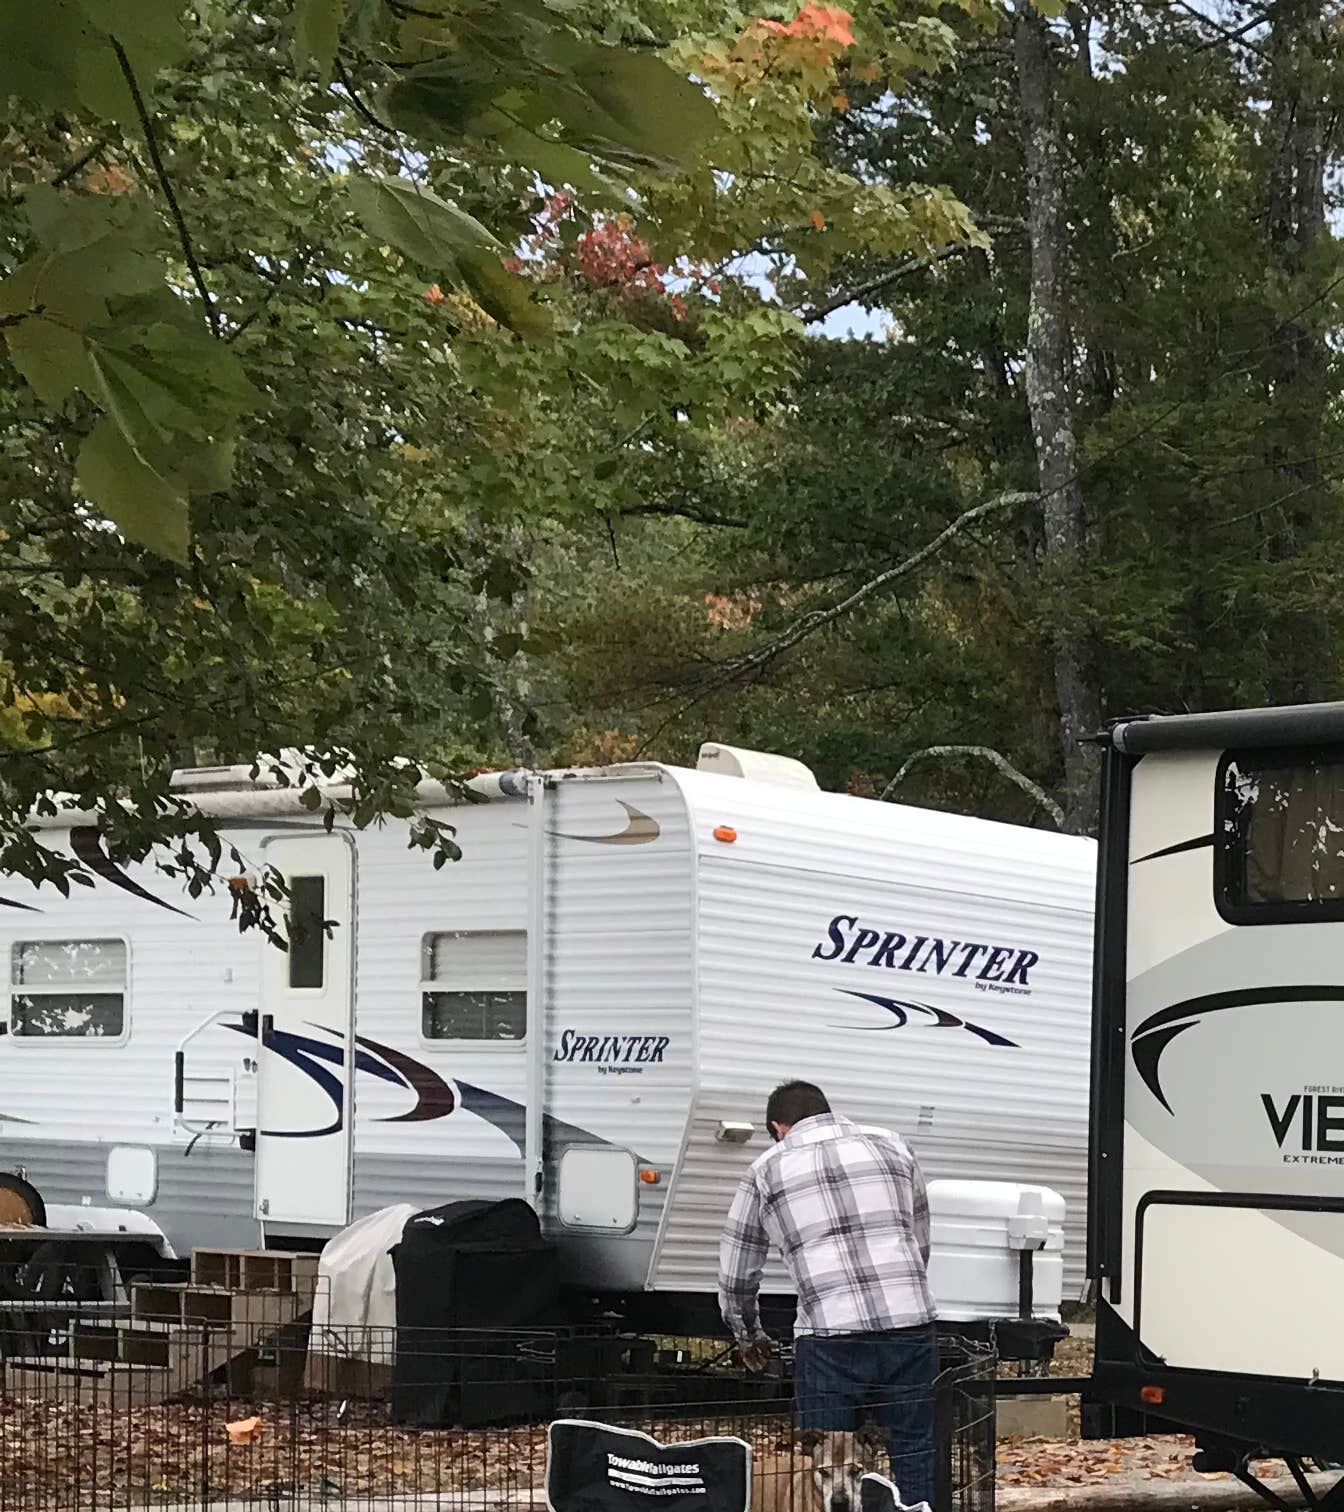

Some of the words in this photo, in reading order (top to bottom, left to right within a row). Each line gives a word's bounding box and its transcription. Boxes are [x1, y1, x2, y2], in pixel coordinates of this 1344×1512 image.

[811, 914, 1040, 986] SPRINTER
[975, 980, 988, 993] by
[988, 983, 1032, 996] Keystone
[553, 1028, 670, 1063] SPRINTER
[1304, 1085, 1331, 1094] FOREST
